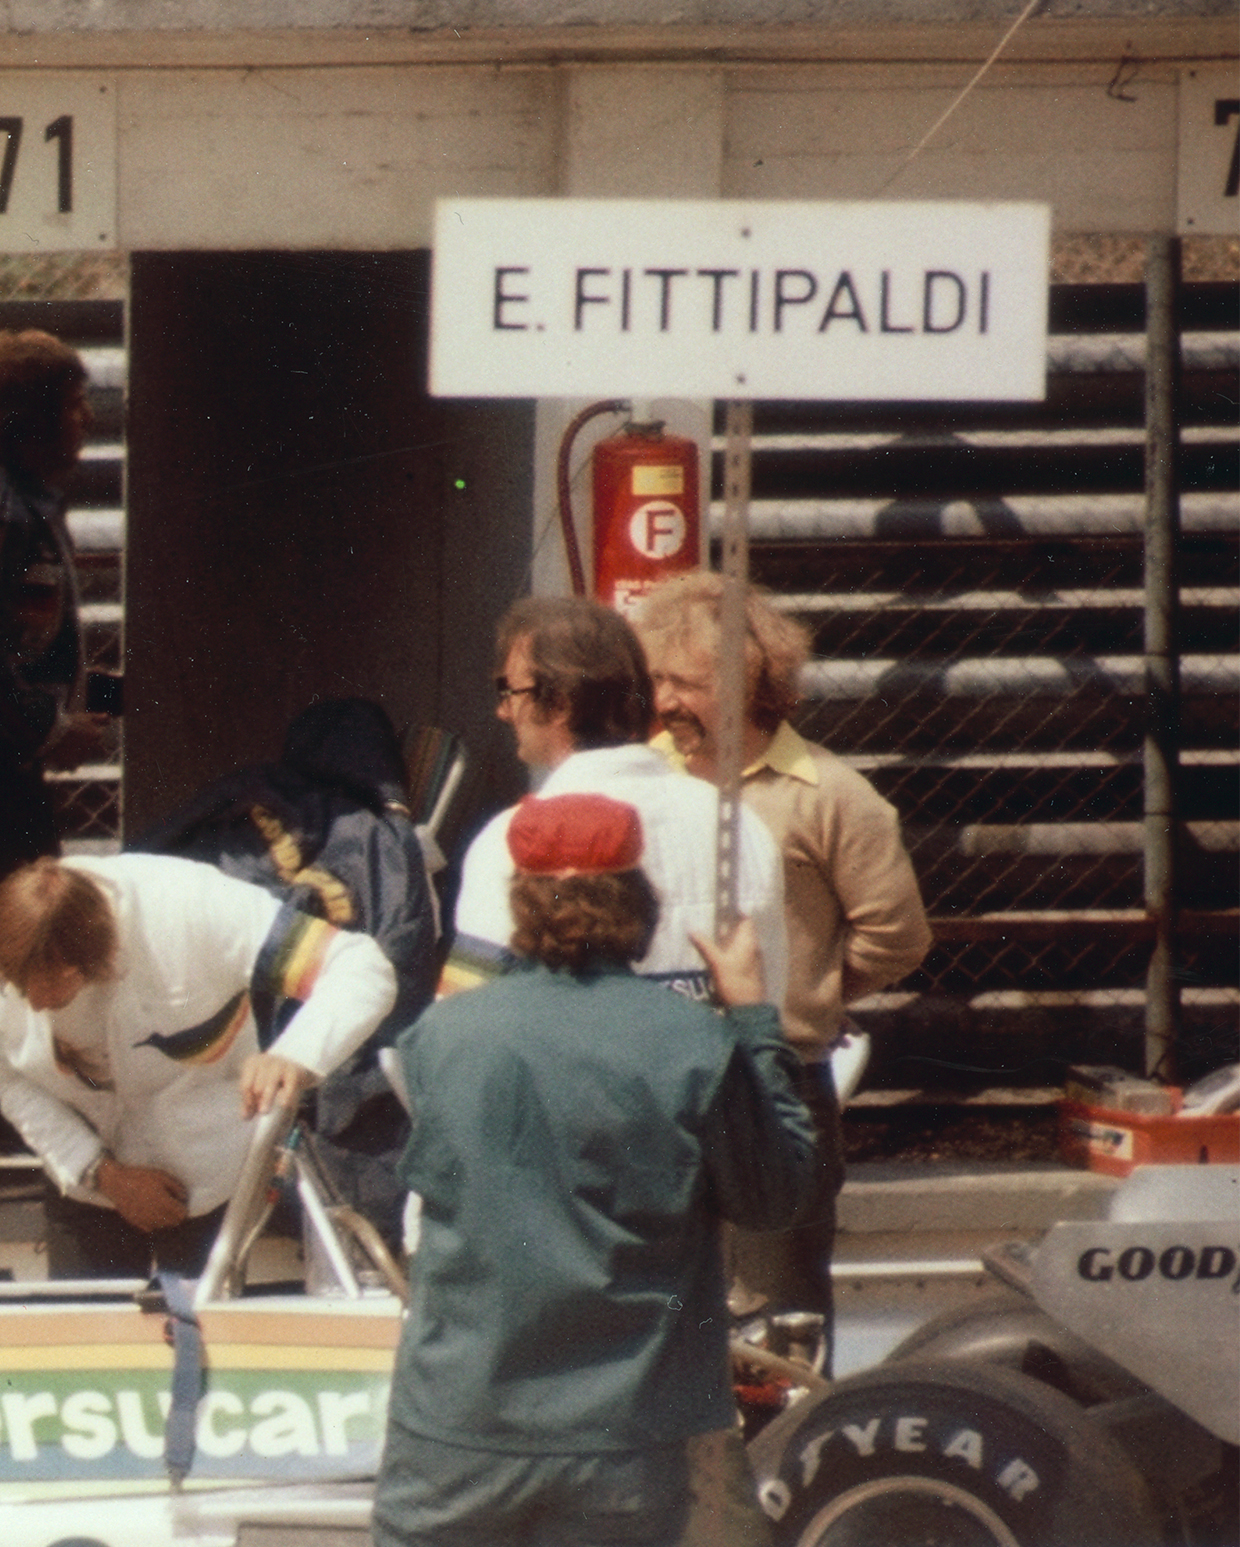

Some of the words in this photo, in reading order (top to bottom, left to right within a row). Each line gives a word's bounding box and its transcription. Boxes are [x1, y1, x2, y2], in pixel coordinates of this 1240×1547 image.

[492, 266, 545, 332] E.
[572, 267, 990, 334] FITTIPALDI
[646, 509, 675, 550] F
